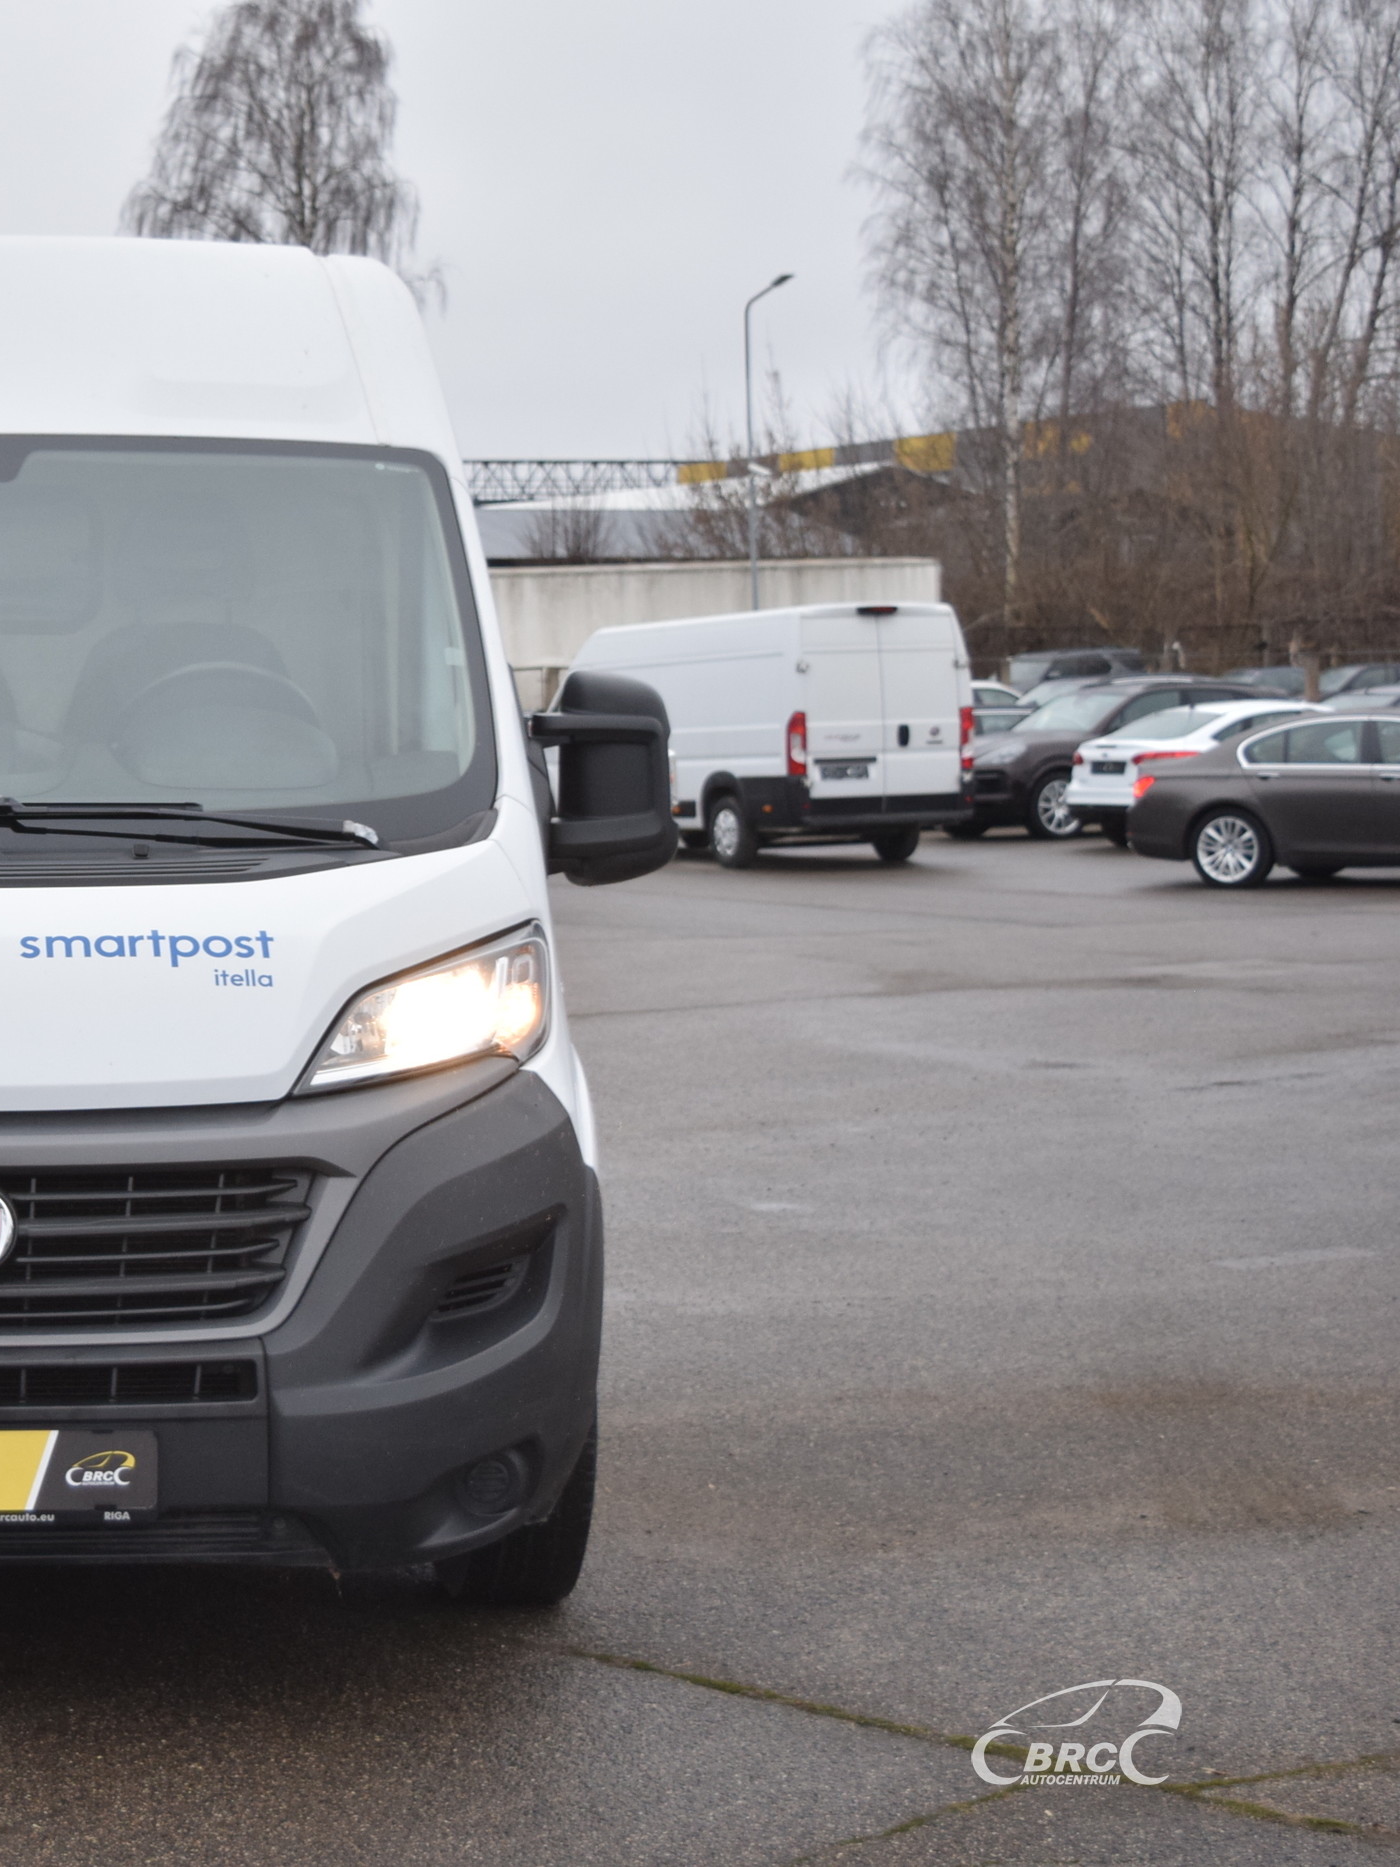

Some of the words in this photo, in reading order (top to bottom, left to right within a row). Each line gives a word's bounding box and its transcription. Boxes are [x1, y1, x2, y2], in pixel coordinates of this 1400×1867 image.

[20, 930, 274, 967] smartpost
[214, 969, 274, 987] itella
[103, 1511, 131, 1521] RIGA
